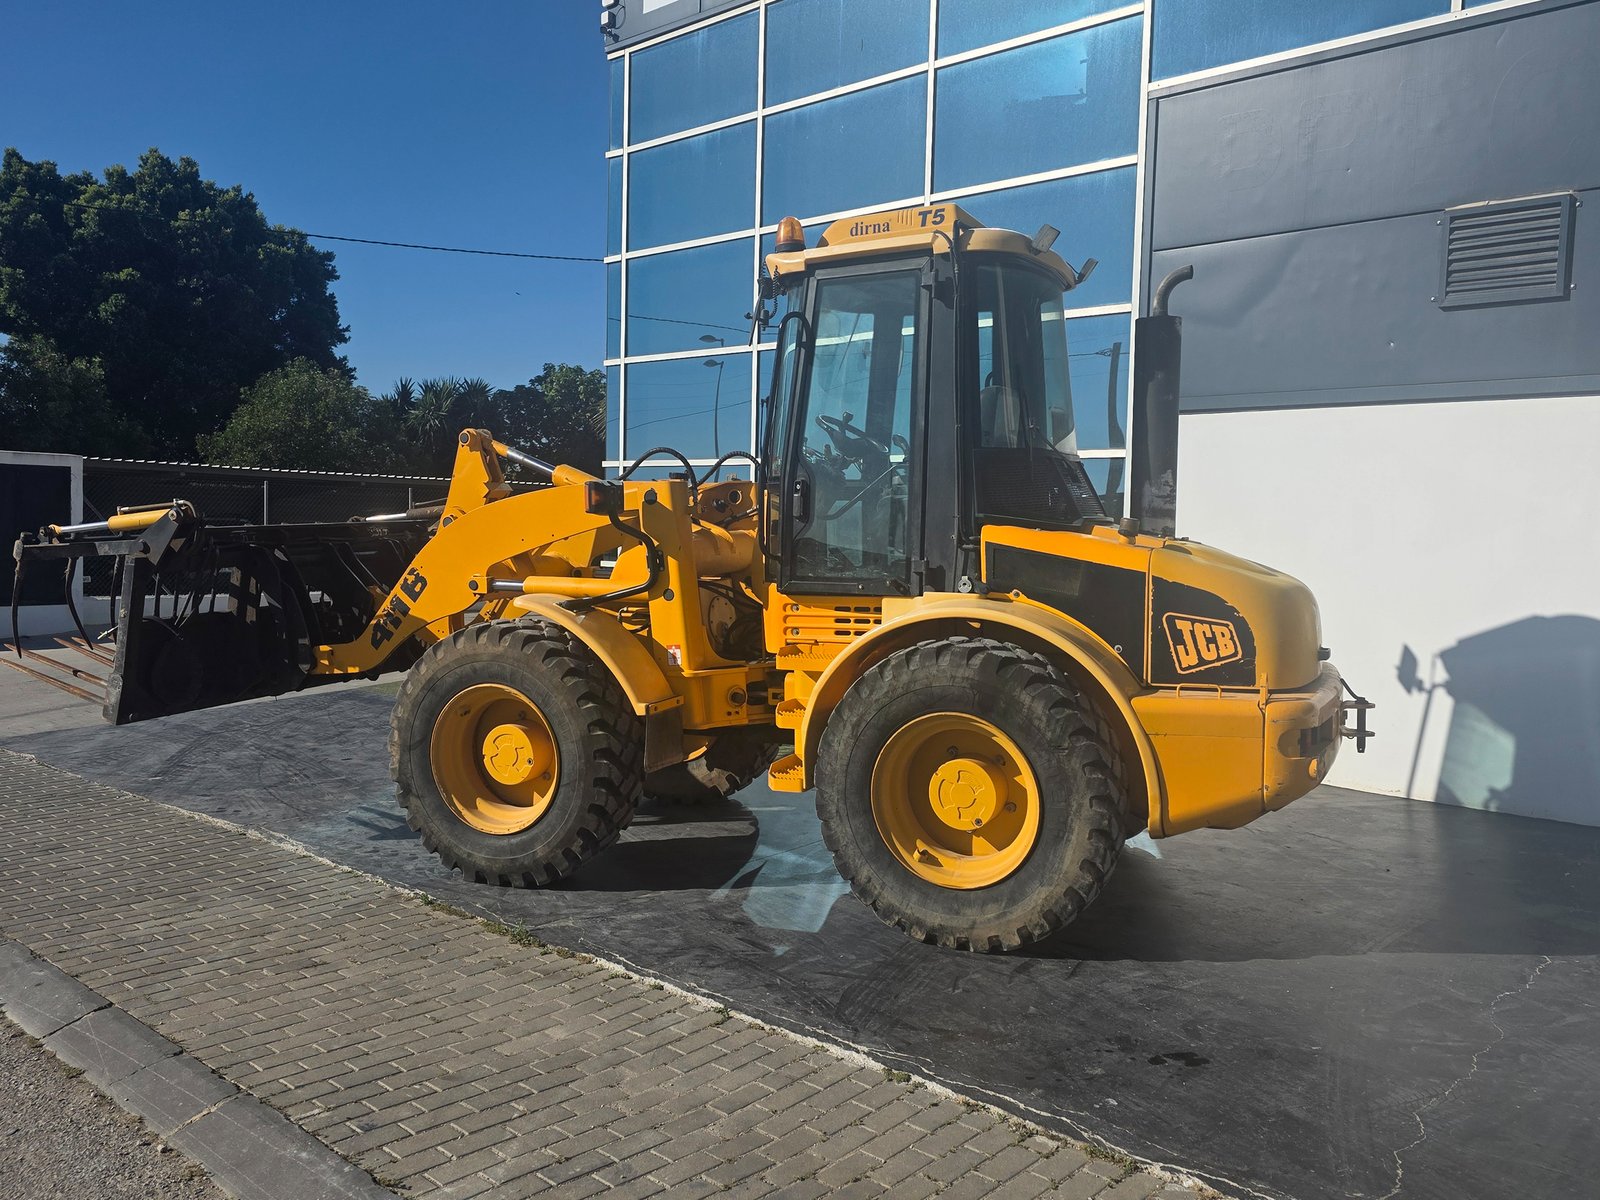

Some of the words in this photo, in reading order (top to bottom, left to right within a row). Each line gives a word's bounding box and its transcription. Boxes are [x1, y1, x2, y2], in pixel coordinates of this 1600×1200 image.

[849, 221, 890, 237] dirna
[918, 208, 946, 228] T5
[1175, 619, 1235, 668] JCB
